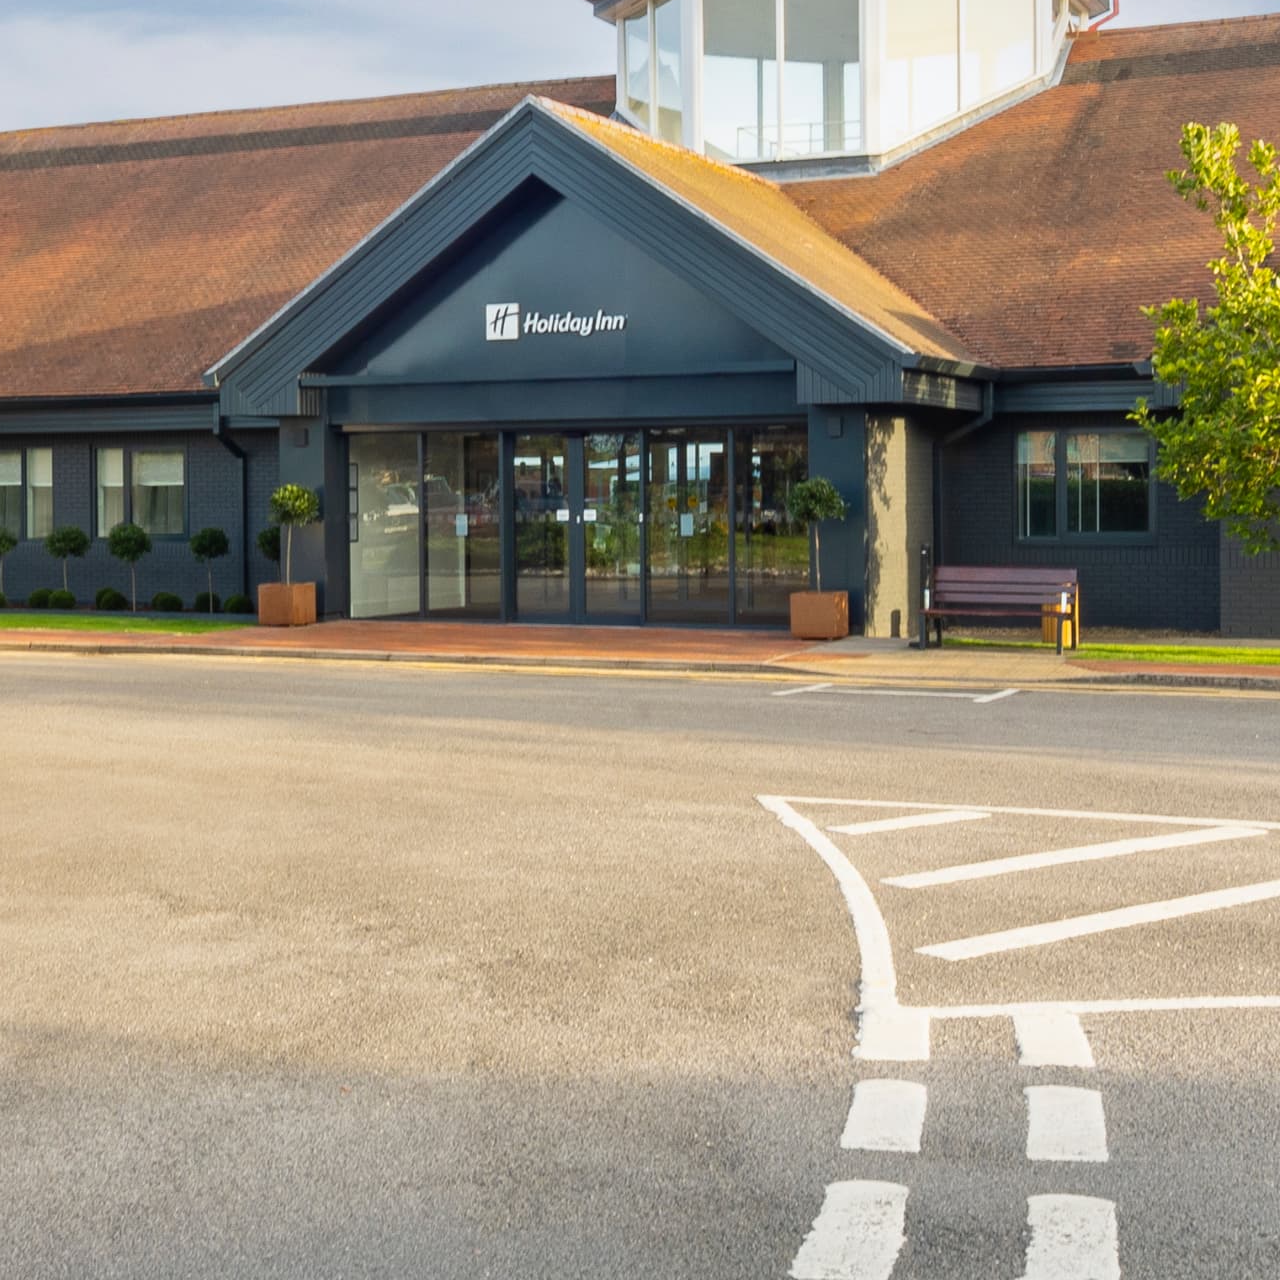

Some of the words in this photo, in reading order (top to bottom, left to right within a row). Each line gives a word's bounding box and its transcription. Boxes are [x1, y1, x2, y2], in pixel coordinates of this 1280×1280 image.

[490, 306, 519, 336] H
[523, 311, 594, 336] Holiday
[595, 309, 625, 331] Inn
